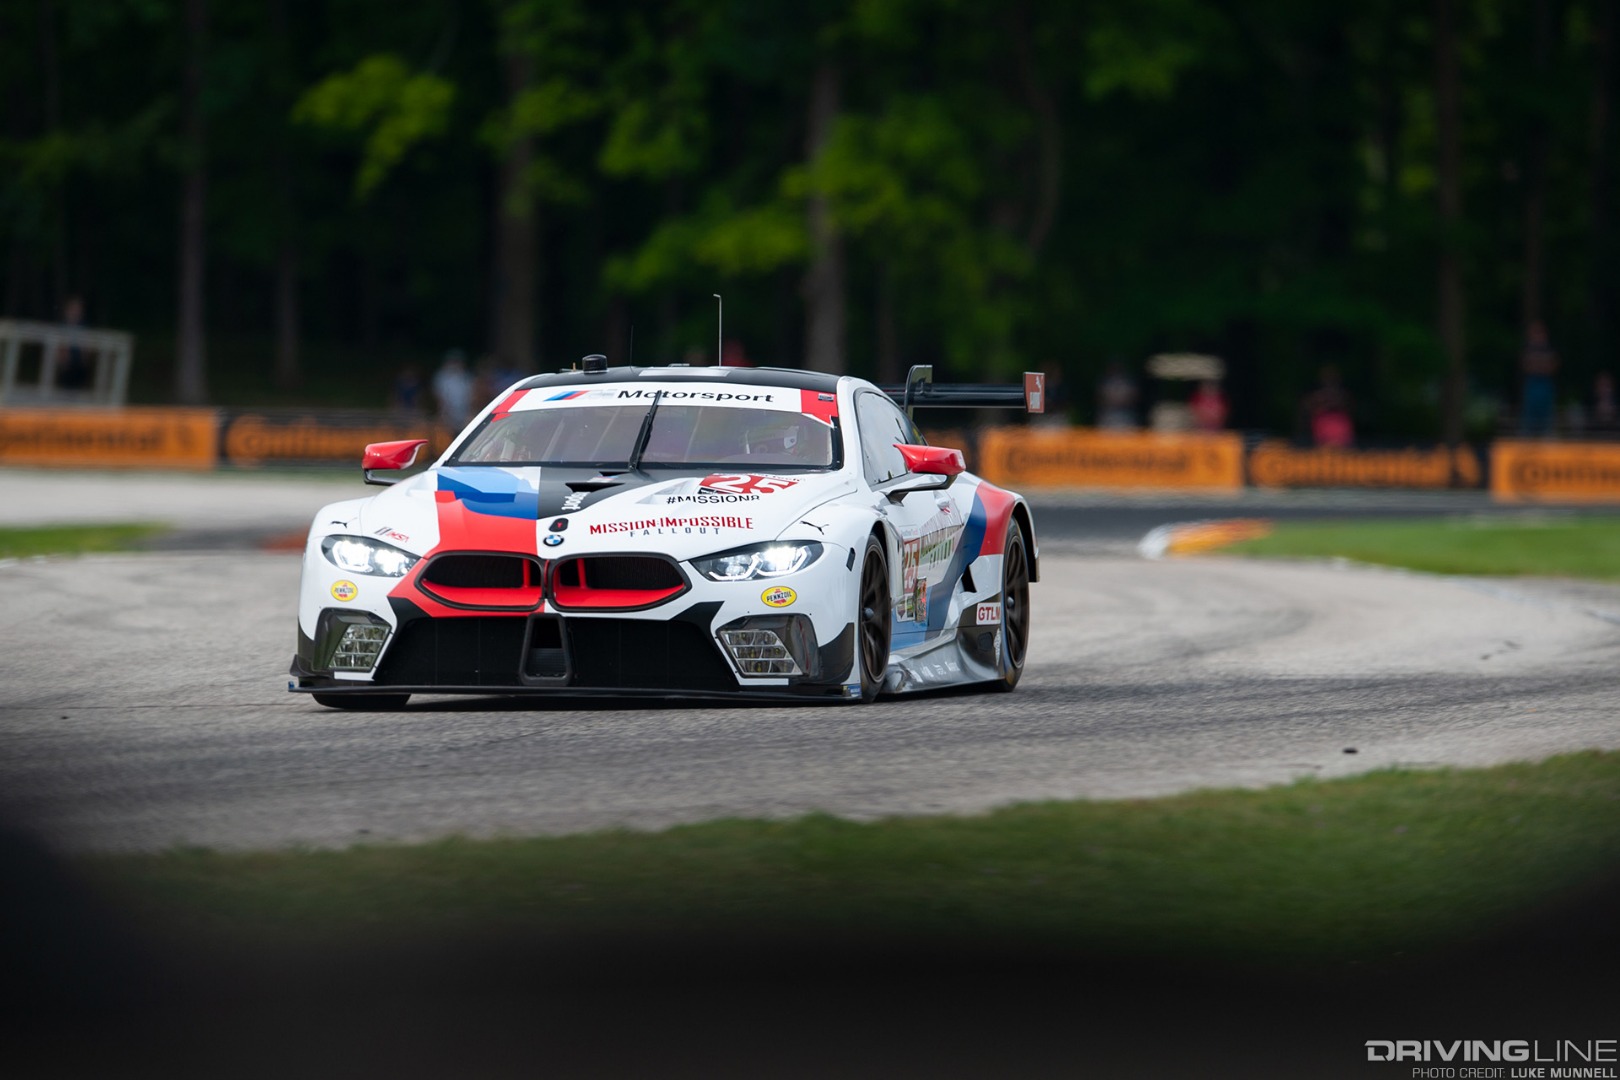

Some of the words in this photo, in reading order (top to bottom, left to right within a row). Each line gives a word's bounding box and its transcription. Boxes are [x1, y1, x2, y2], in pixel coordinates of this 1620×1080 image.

[617, 390, 774, 403] Motorsport
[706, 473, 791, 495] 25
[629, 526, 721, 538] FALLOUT
[766, 590, 793, 603] PENNZOIL
